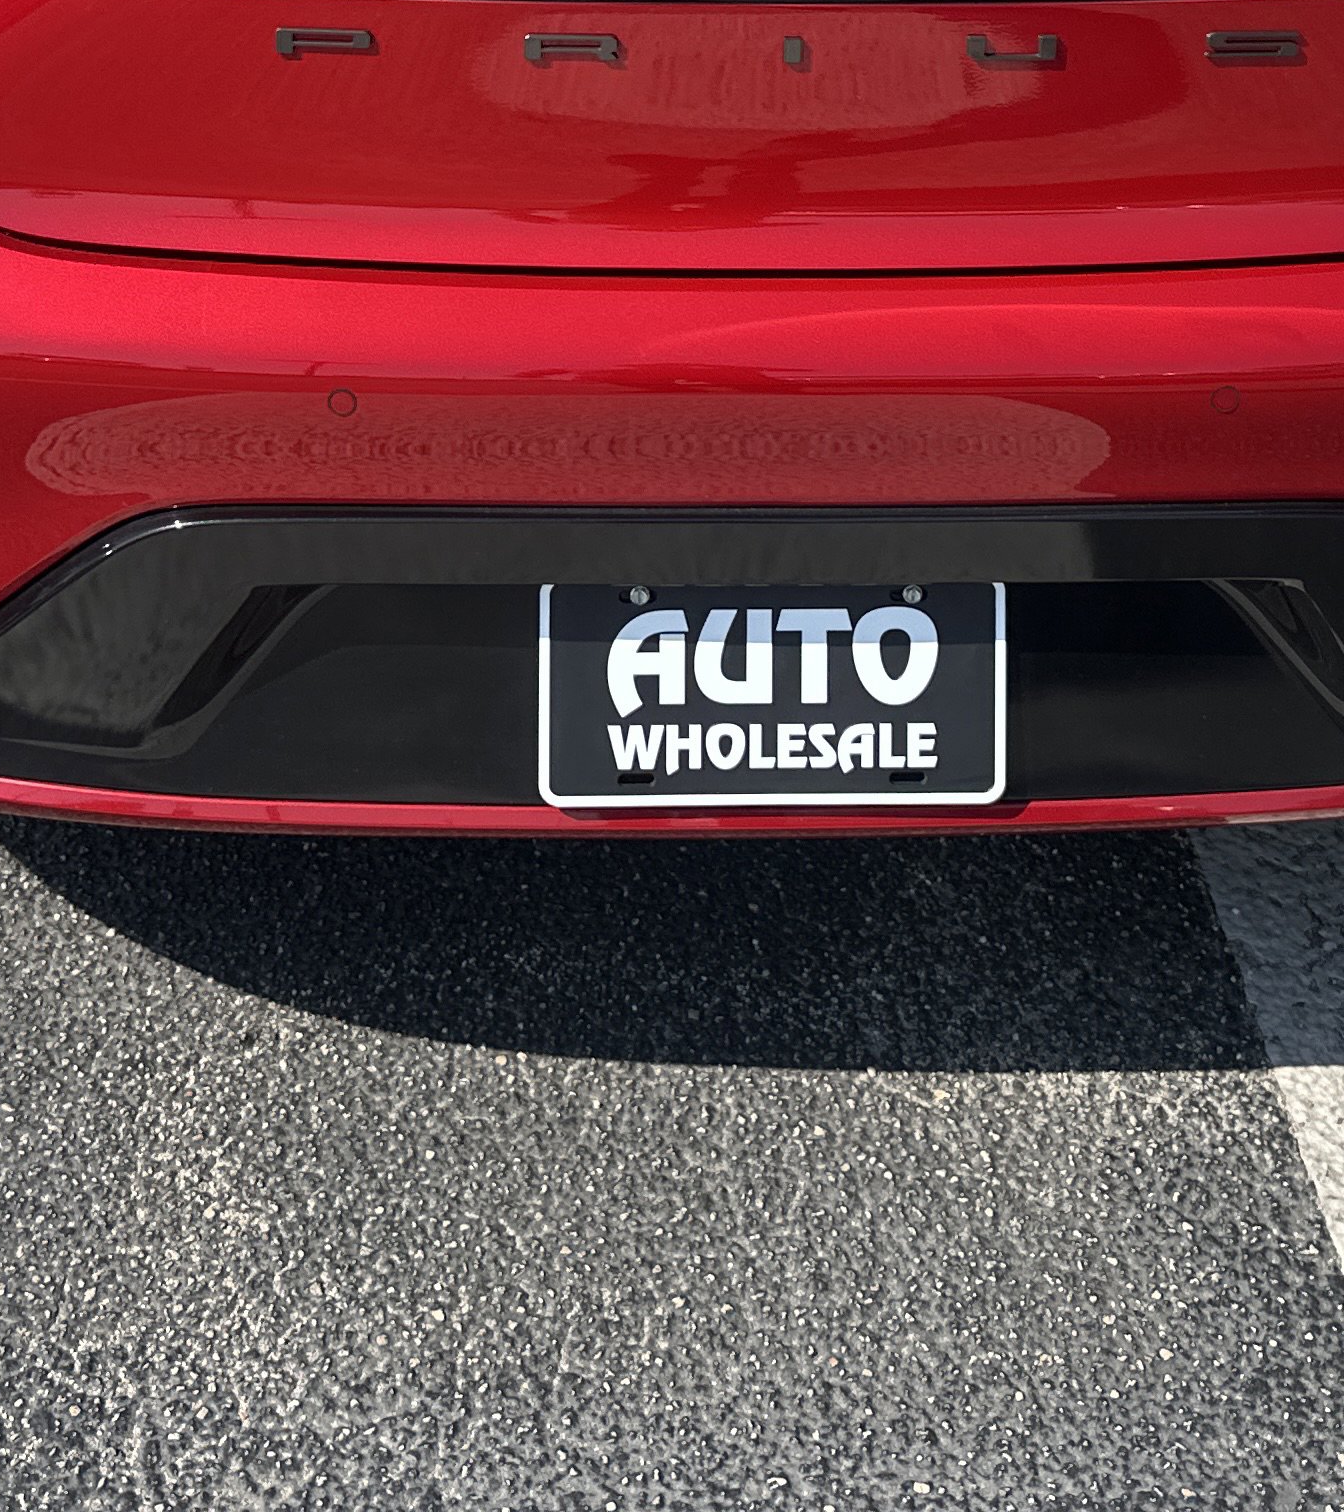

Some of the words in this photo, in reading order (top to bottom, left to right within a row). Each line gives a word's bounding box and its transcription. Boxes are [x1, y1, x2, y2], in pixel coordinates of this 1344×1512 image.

[276, 27, 1299, 62] PRIUS
[607, 605, 939, 718] AUTO
[607, 722, 939, 776] WHOLESALE
